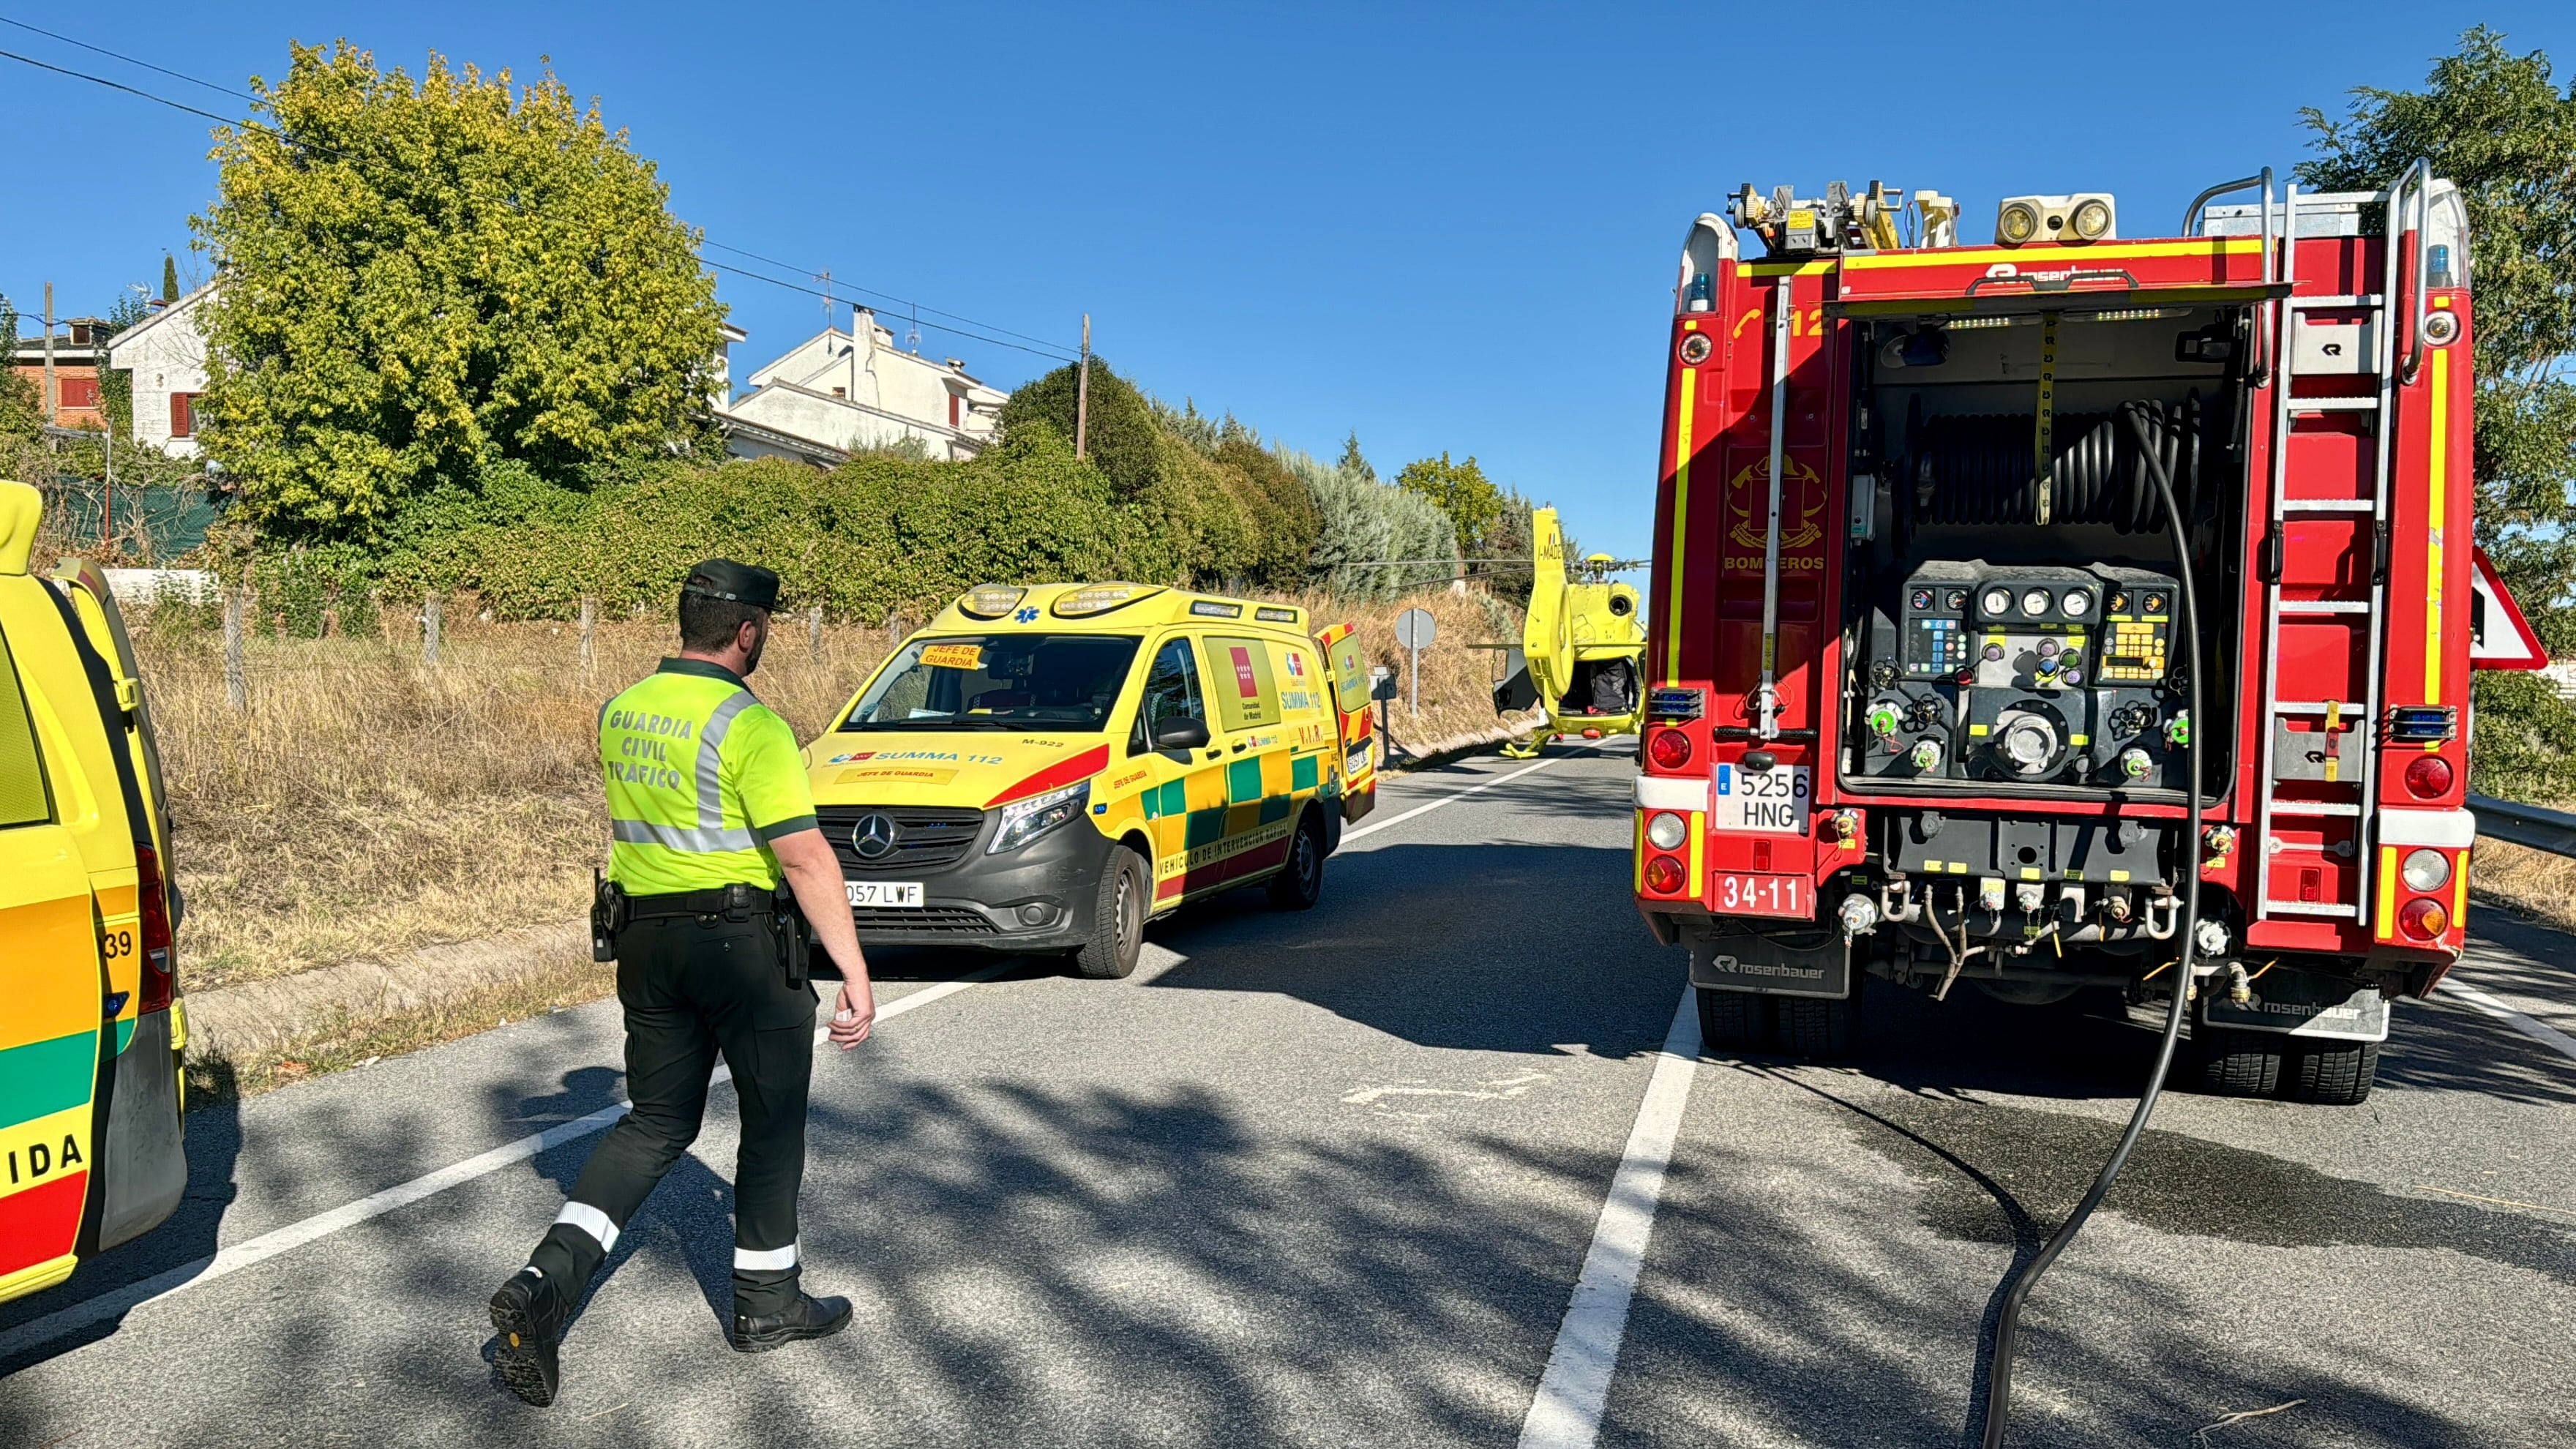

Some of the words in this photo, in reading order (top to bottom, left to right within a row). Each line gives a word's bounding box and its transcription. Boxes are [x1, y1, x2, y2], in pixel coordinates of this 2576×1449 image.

[1724, 557, 1824, 569] BOMEROS
[933, 645, 961, 654] JEFE
[961, 647, 978, 656] DE
[925, 654, 973, 667] GUARDIA
[1281, 692, 1309, 710] SUMMA
[1309, 692, 1321, 708] 112
[610, 710, 692, 739] GUARDIA
[621, 736, 666, 762] CIVIL
[1022, 739, 1065, 747] M-922
[875, 752, 958, 761] SUMMA
[967, 755, 1003, 765] 112
[607, 760, 681, 790] TRAFICO
[1721, 782, 1728, 790] E
[1741, 772, 1808, 798] 5256
[1744, 801, 1794, 827] HNG
[1159, 851, 1199, 875] VEHÍCULO
[1202, 847, 1212, 861] DE
[1215, 831, 1265, 858] INTERVENCIÓN
[883, 886, 918, 902] LWF
[1723, 876, 1797, 910] 34-11
[100, 930, 132, 959] 39
[1739, 962, 1825, 979] rosenbauer
[2264, 1001, 2362, 1020] rosenbauer
[8, 1134, 83, 1184] IDA
